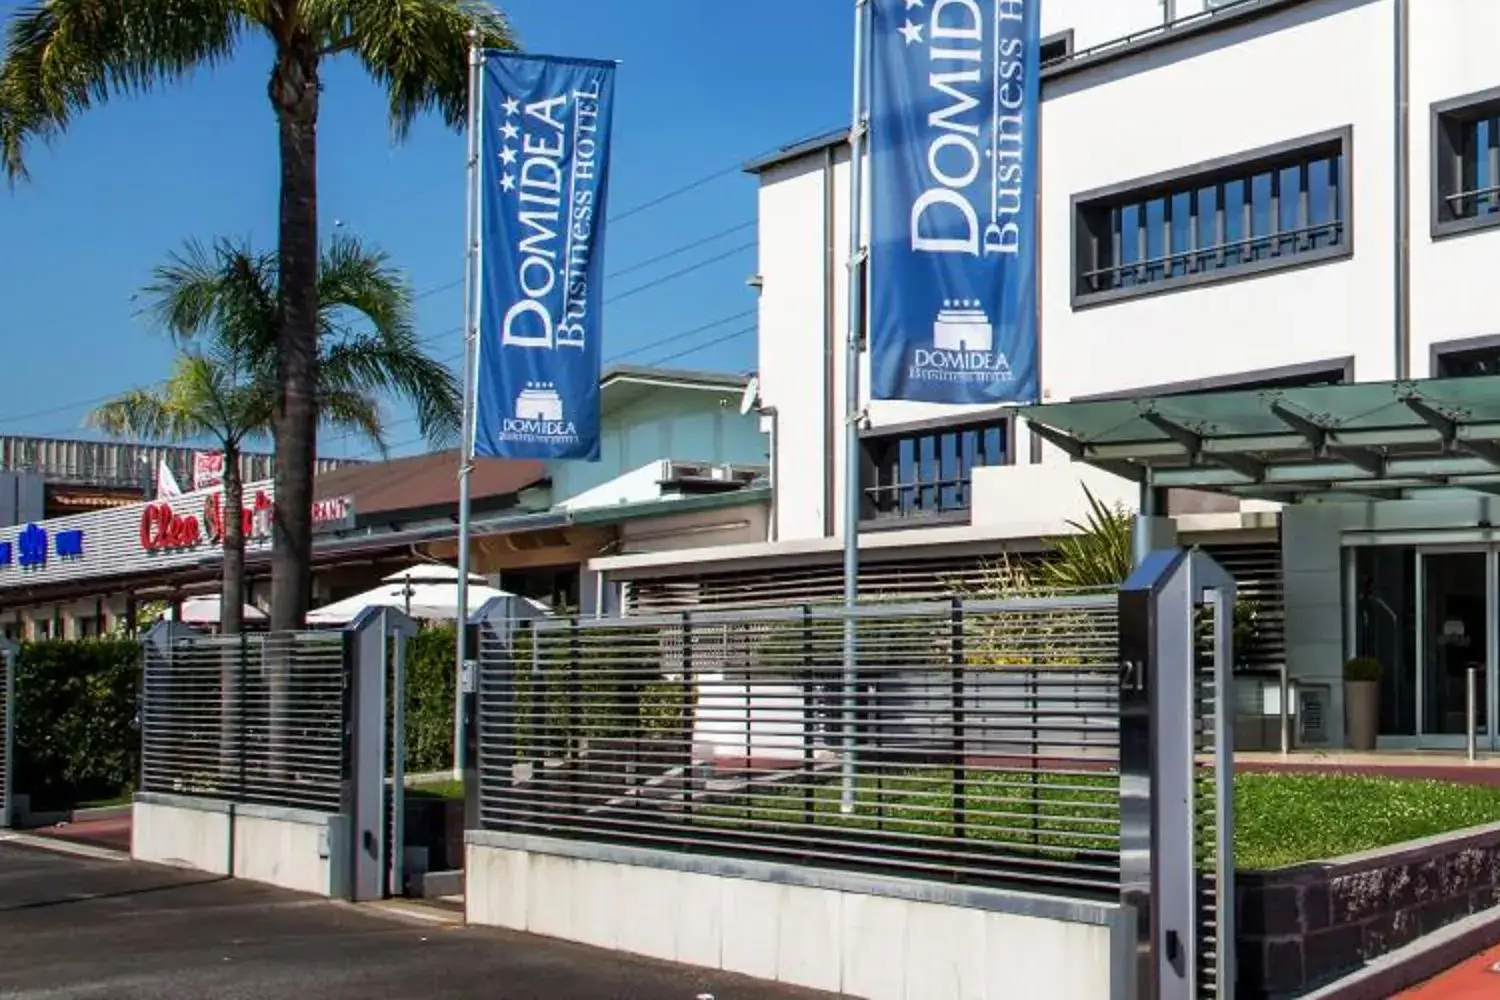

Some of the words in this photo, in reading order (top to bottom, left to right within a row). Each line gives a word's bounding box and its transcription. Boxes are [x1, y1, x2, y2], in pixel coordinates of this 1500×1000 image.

[573, 79, 600, 180] HOTEL
[984, 39, 1022, 256] Business
[502, 94, 567, 349] DOMIDEA
[556, 194, 593, 352] Business
[915, 349, 1009, 369] DOMIDEA
[503, 418, 577, 435] DOMIDEA
[1121, 660, 1143, 690] 21
